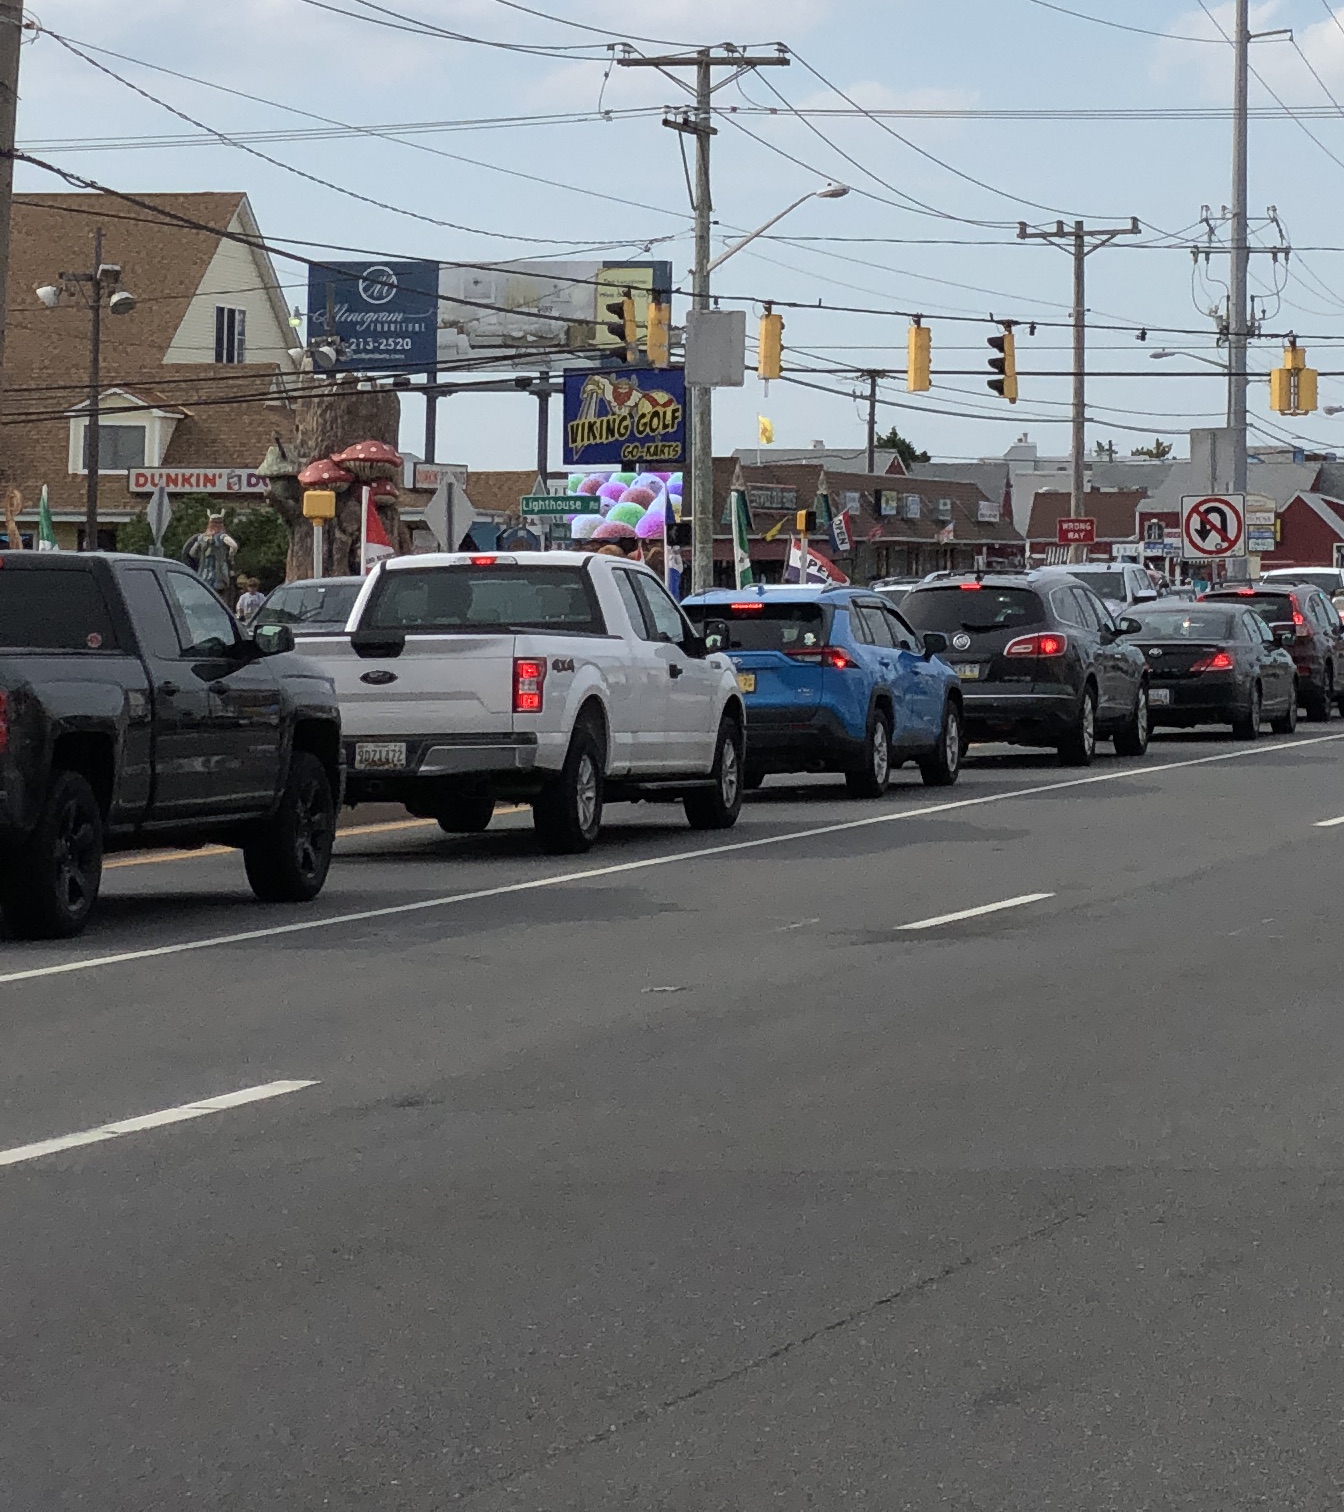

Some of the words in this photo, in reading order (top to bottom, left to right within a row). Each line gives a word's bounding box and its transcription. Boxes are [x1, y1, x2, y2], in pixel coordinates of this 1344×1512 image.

[567, 413, 631, 451] VIKING
[635, 405, 683, 437] GOLF
[621, 442, 683, 461] GO-KARTS
[134, 471, 223, 489] DUNKIN'
[522, 499, 582, 513] Lighthouse
[1062, 521, 1092, 531] WRONG
[1067, 530, 1085, 540] WAY
